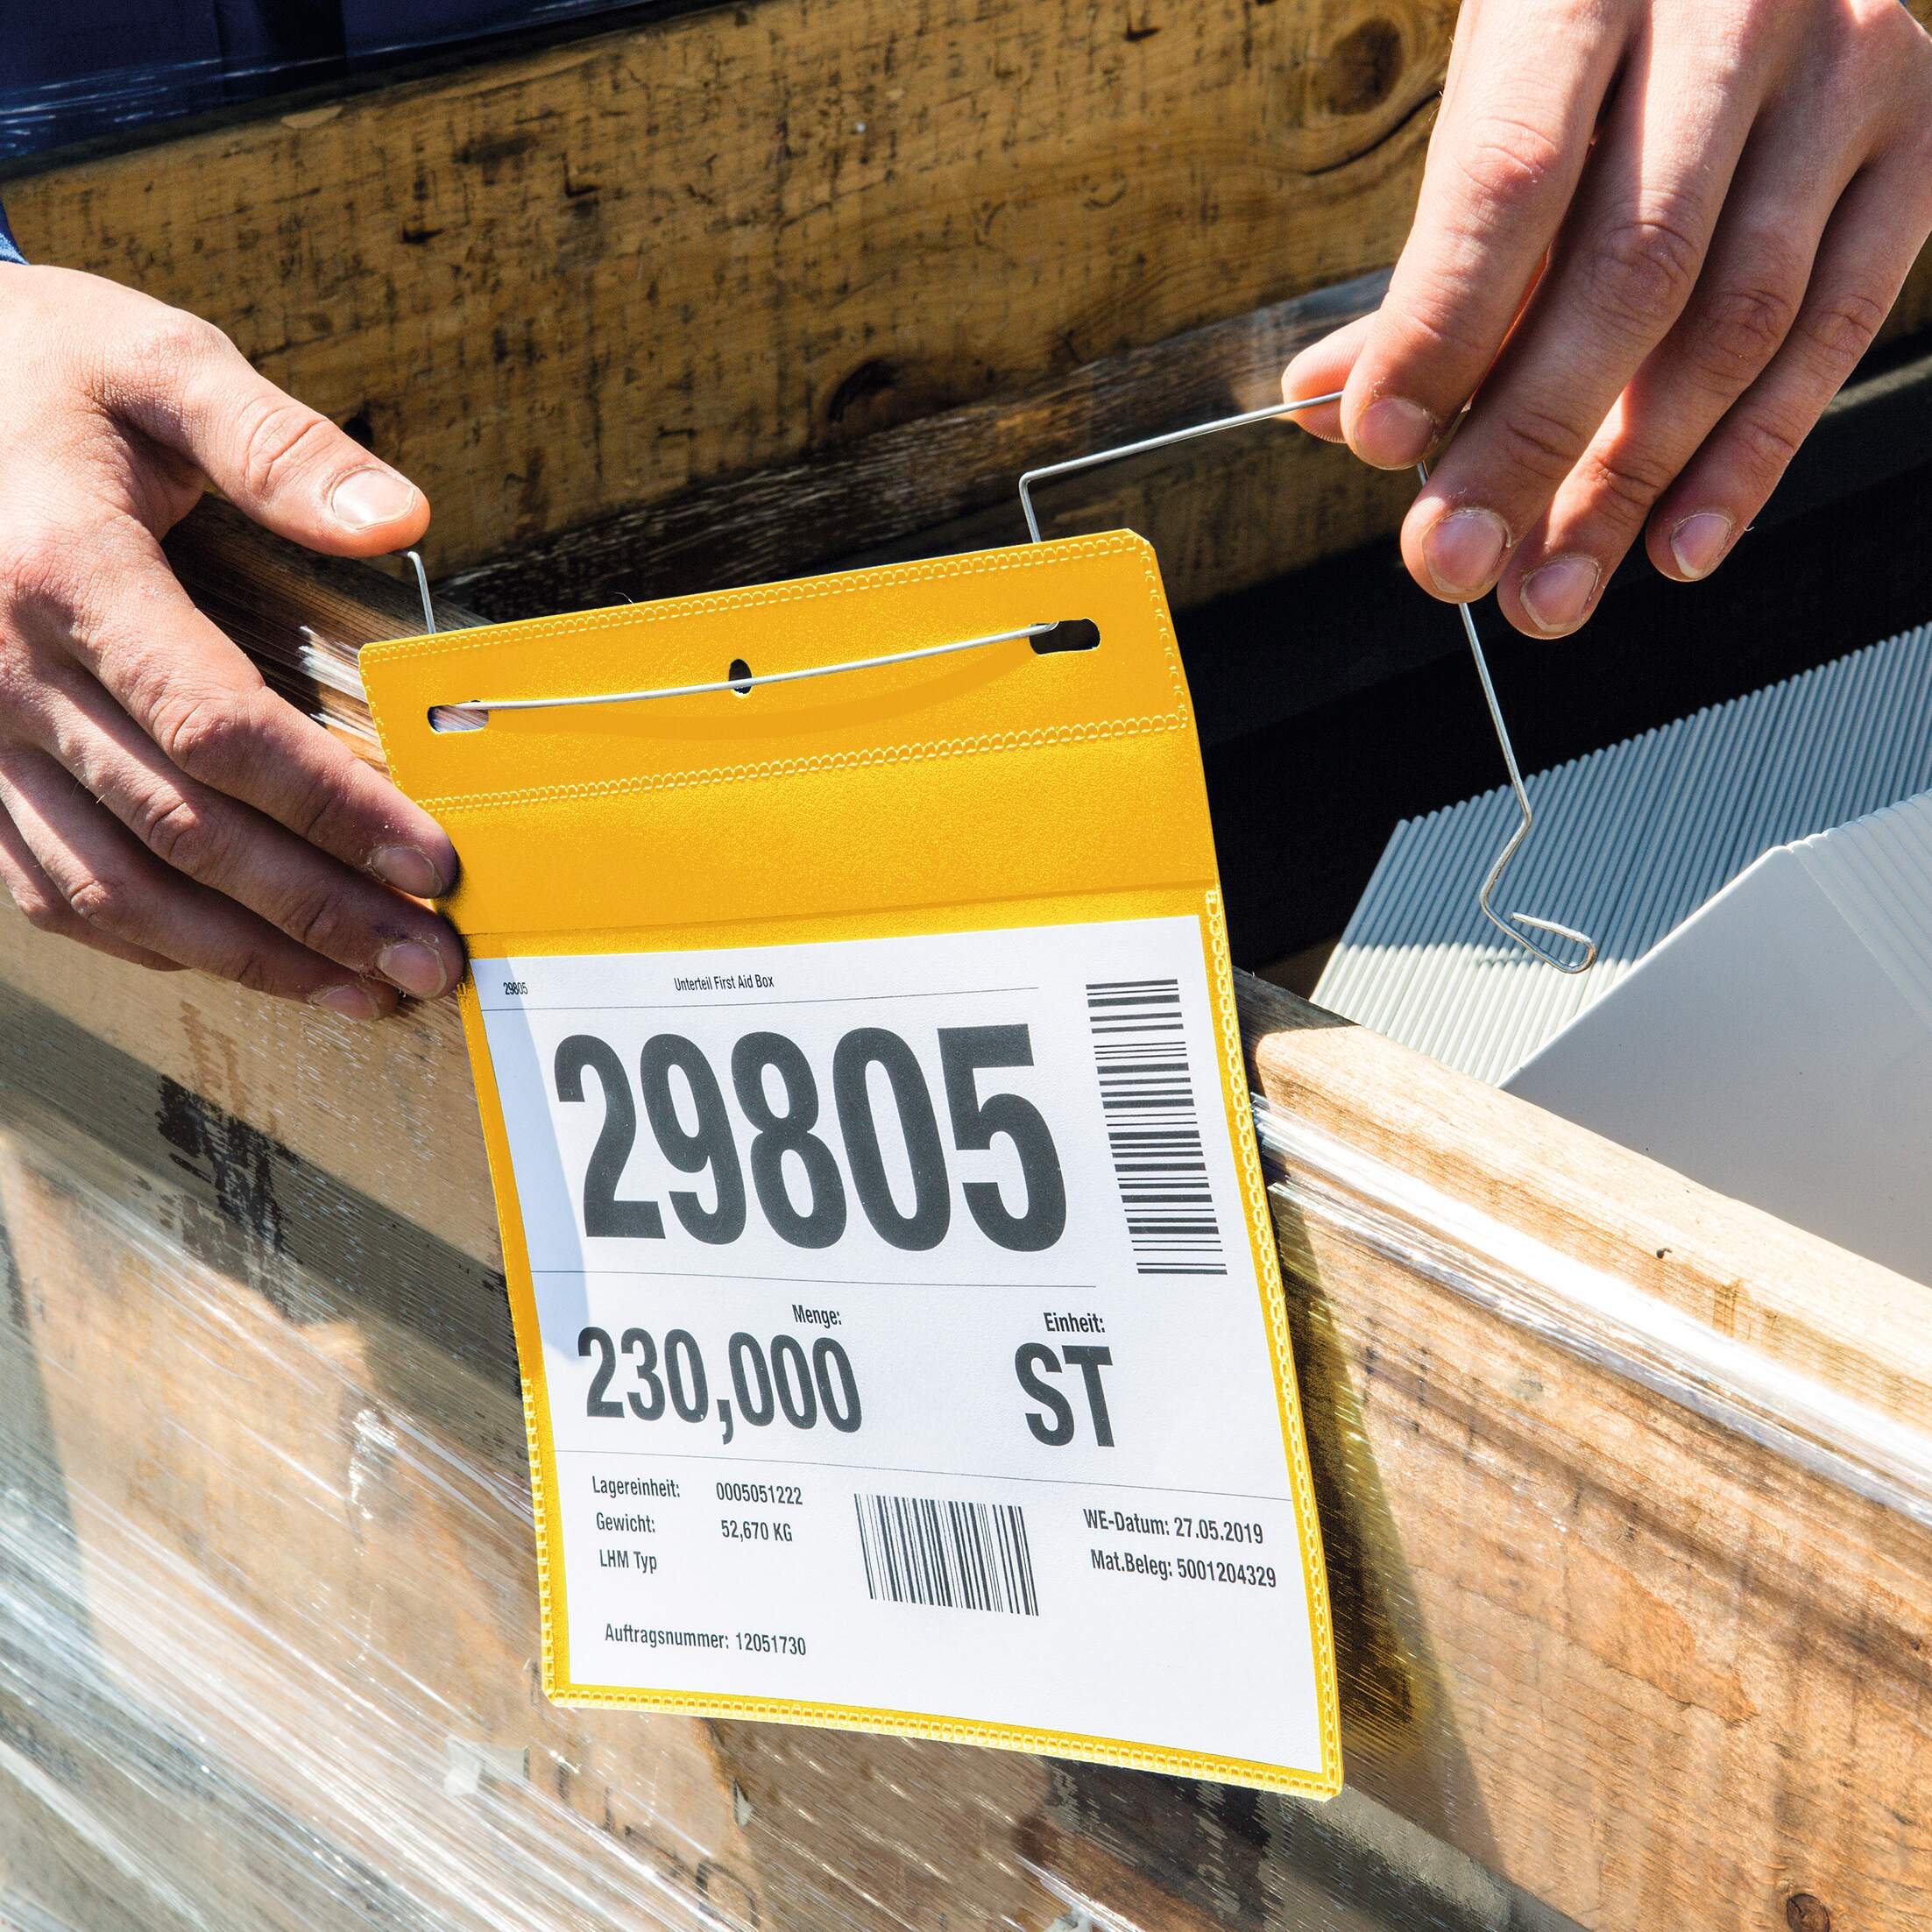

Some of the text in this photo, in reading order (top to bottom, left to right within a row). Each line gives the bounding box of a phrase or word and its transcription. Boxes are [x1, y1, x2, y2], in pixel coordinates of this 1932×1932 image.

[502, 981, 528, 995] 29805
[673, 973, 775, 992] Unterteil First Aid Box
[554, 1023, 1067, 1252] 29805
[791, 1304, 842, 1326] Menge:
[1043, 1312, 1106, 1334] Einheit:
[577, 1327, 862, 1445] 230,000
[1015, 1342, 1115, 1447] ST
[591, 1476, 681, 1499] Lagereinheit:
[716, 1482, 803, 1505] 0005051222
[596, 1511, 655, 1533] Gewicht:
[721, 1519, 793, 1543] 52,670 KG
[1082, 1508, 1263, 1545] WE-Datum: 27.05.2019
[599, 1549, 657, 1575] LHM Typ
[1090, 1548, 1277, 1589] Mat.Beleg: 5001204329
[605, 1624, 806, 1656] Auftragsnummer: 12051730
